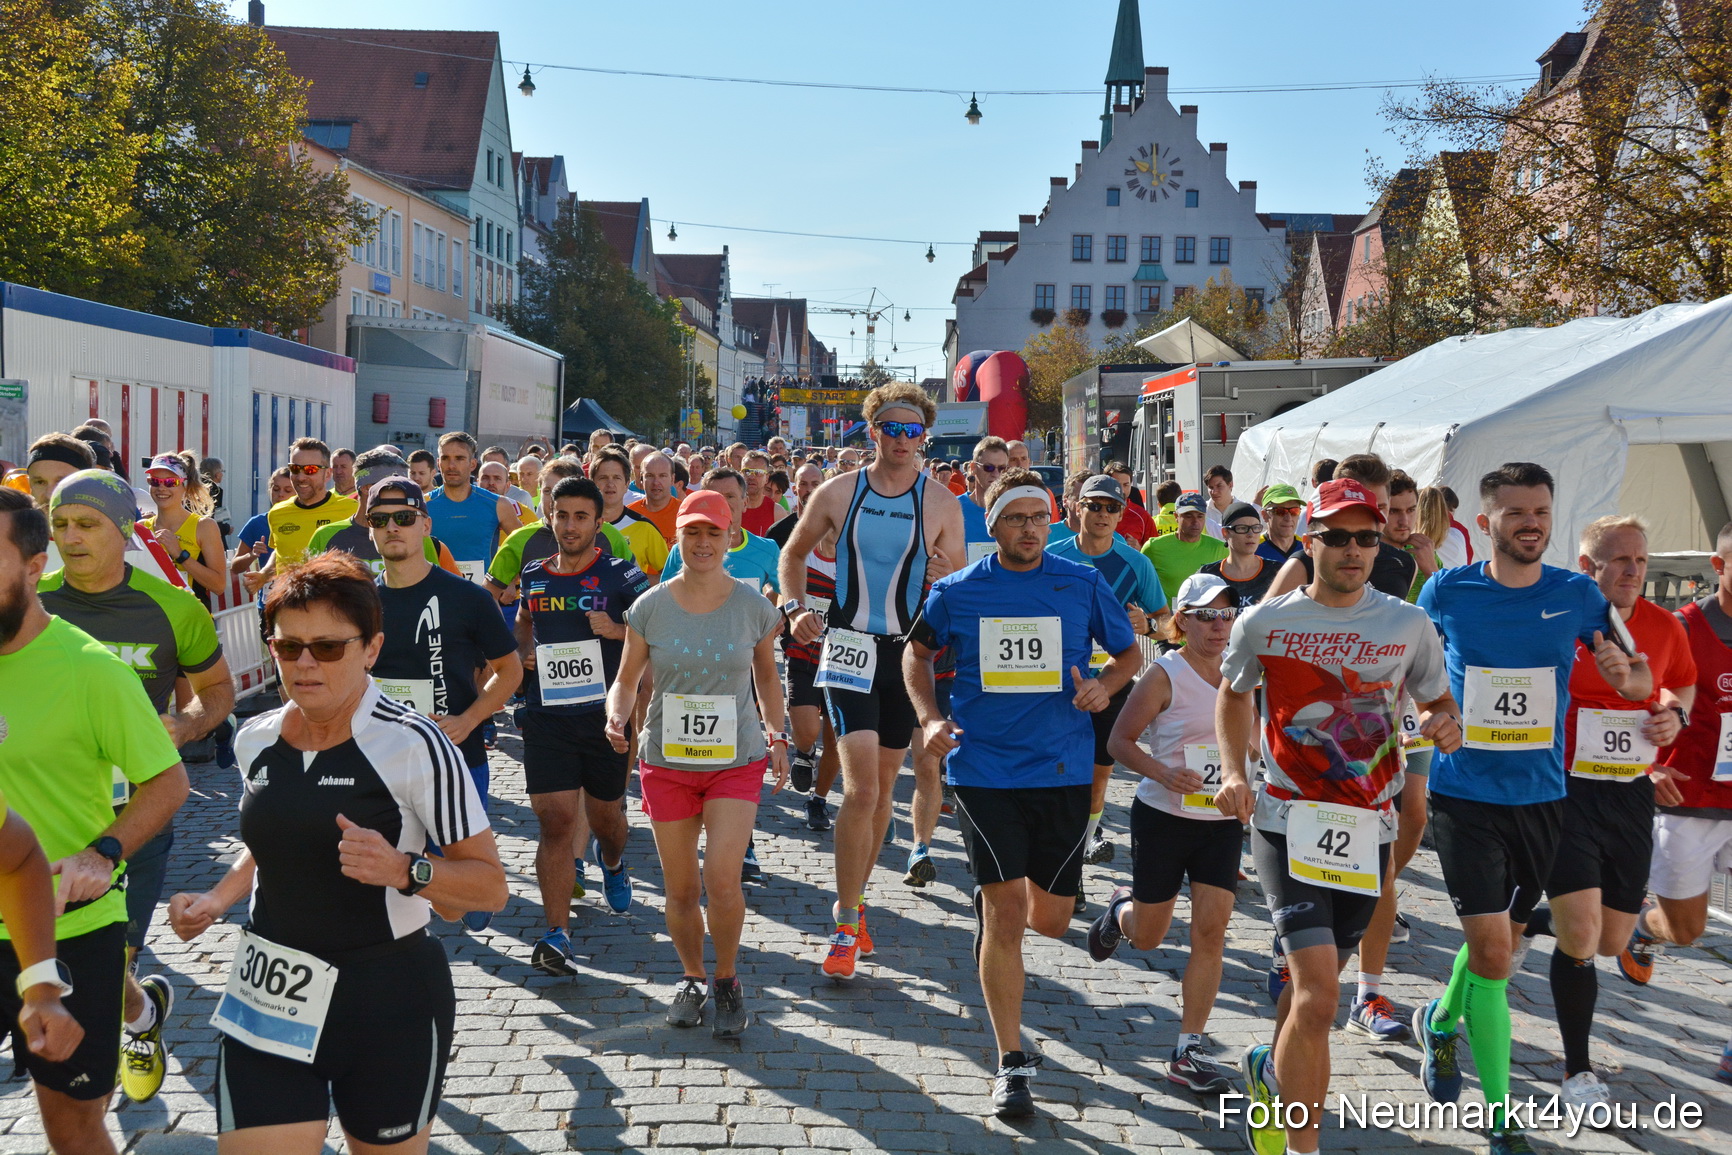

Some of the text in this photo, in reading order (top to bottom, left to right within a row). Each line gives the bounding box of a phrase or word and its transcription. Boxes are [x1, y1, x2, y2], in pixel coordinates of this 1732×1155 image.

[811, 392, 846, 402] START
[528, 595, 608, 612] MENSCH
[1002, 623, 1038, 632] BOCK
[834, 632, 863, 645] BOCK
[1265, 629, 1361, 648] FINISHER
[553, 647, 581, 657] BOCK
[999, 638, 1043, 660] 319
[1285, 641, 1406, 660] RELAY TEAM
[1312, 656, 1379, 666] ROTH 2016
[547, 658, 593, 679] 3066
[1491, 676, 1532, 686] BOCK
[382, 685, 411, 693] BOCK
[684, 701, 715, 710] BOCK
[1494, 692, 1527, 716] 43
[681, 714, 720, 735] 157
[1602, 716, 1636, 726] BOCK
[1491, 731, 1528, 741] Florian
[1604, 731, 1632, 753] 96
[1724, 732, 1732, 752] 3
[685, 747, 713, 757] Maren
[1593, 764, 1636, 775] Christian
[318, 775, 356, 786] Johanna
[1316, 810, 1357, 826] BOCK
[1317, 828, 1351, 858] 42
[1303, 856, 1351, 869] PARTL Neumarkt
[1320, 870, 1342, 883] Tim
[240, 944, 313, 1003] 3062
[239, 987, 286, 1013] PARTL Neumarkt
